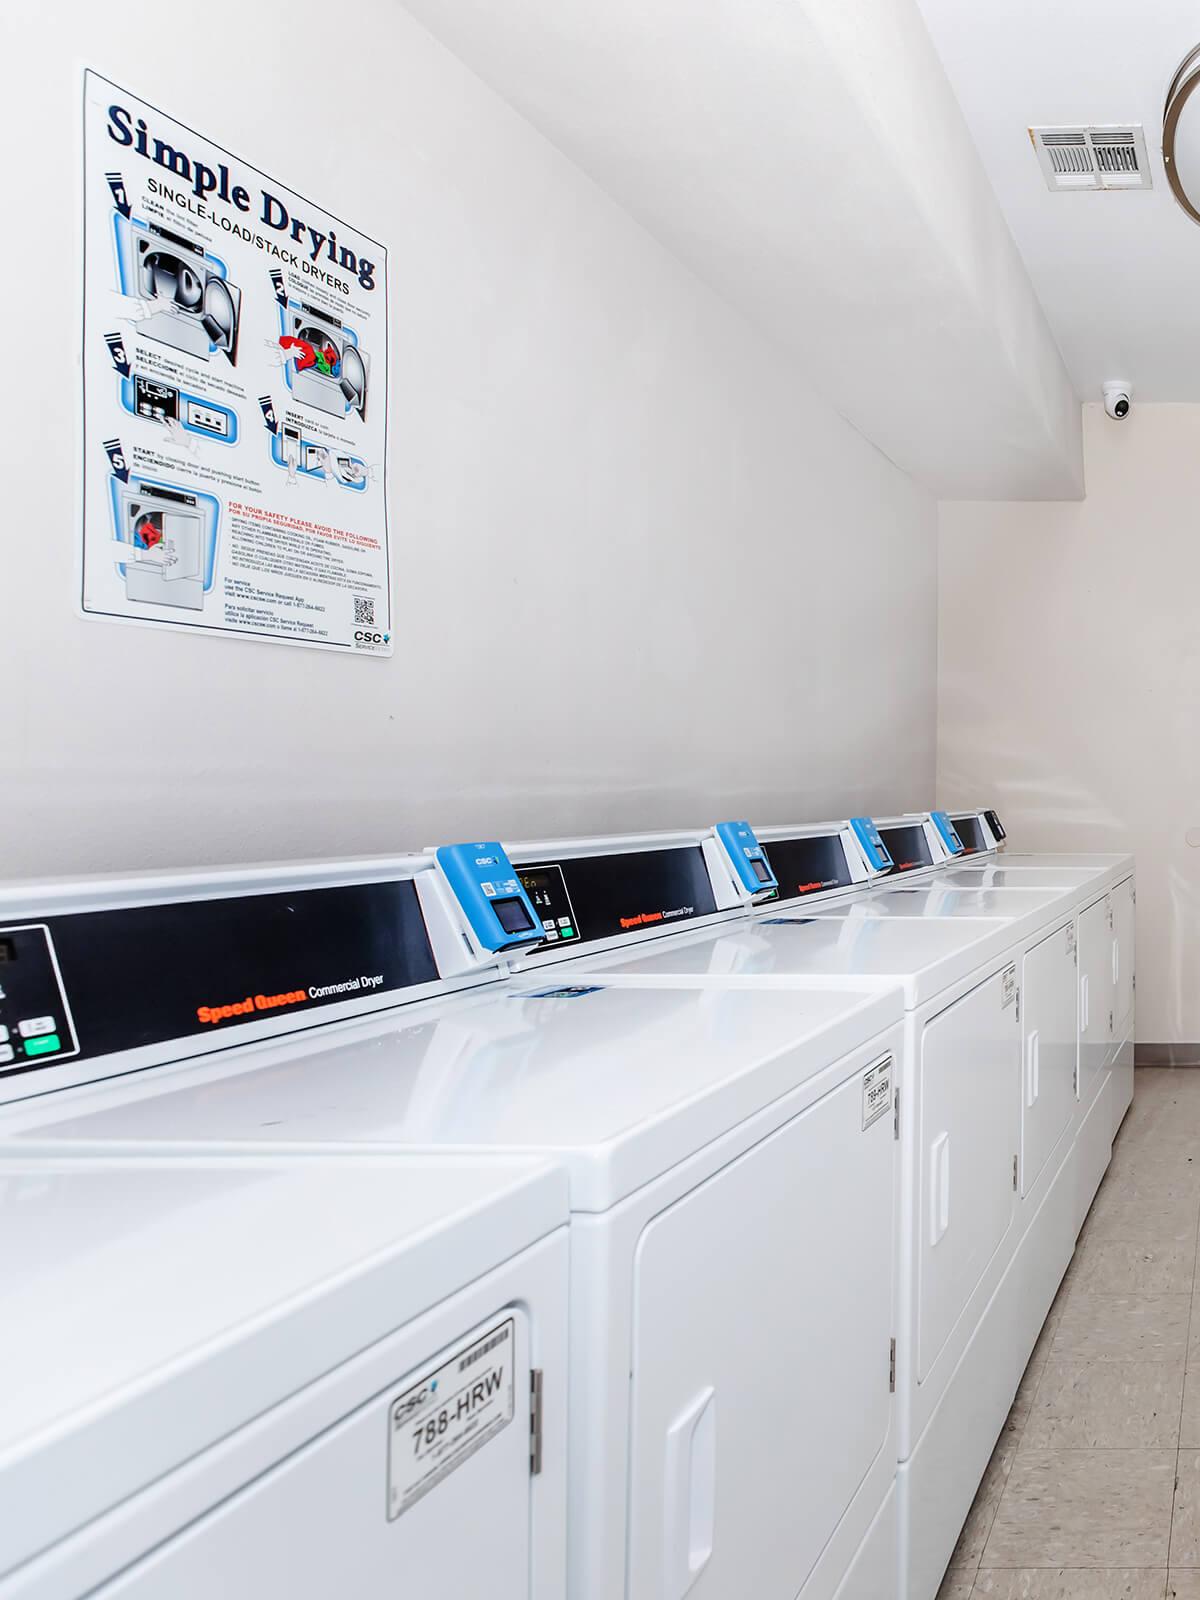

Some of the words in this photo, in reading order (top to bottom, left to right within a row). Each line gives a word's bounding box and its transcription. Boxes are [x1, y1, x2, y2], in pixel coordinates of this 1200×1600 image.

[107, 105, 250, 212] Simple
[260, 190, 376, 291] Drying
[148, 178, 298, 268] SINGLE-LOAD/STACK
[302, 261, 350, 295] DRYERS
[275, 281, 285, 295] 2
[114, 348, 125, 364] 3
[135, 347, 162, 360] SELECT
[135, 355, 178, 374] SELECCIONE
[265, 410, 273, 422] 4
[286, 410, 304, 420] INSERT
[286, 417, 317, 432] INTRODUZCA
[133, 446, 155, 457] START
[112, 454, 125, 470] 5
[133, 454, 176, 470] ENCIENDIDO
[228, 501, 243, 510] FOR
[244, 505, 263, 515] YOUR
[264, 510, 289, 522] SAFETY
[290, 517, 312, 529] PLEASE
[314, 523, 332, 533] AVOID
[333, 528, 344, 537] THE
[345, 531, 378, 544] FOLLOWING
[251, 513, 272, 523] PROPIA
[244, 587, 256, 595] CSC
[256, 589, 274, 598] Service
[275, 593, 294, 602] Request
[354, 630, 382, 644] CSC
[475, 857, 493, 865] CSC
[197, 998, 254, 1024] Speed
[255, 989, 307, 1011] Queen
[308, 977, 361, 999] Commercial
[361, 974, 384, 989] Dryer
[393, 1388, 429, 1422] CSC
[412, 1365, 504, 1457] 788-HRW
